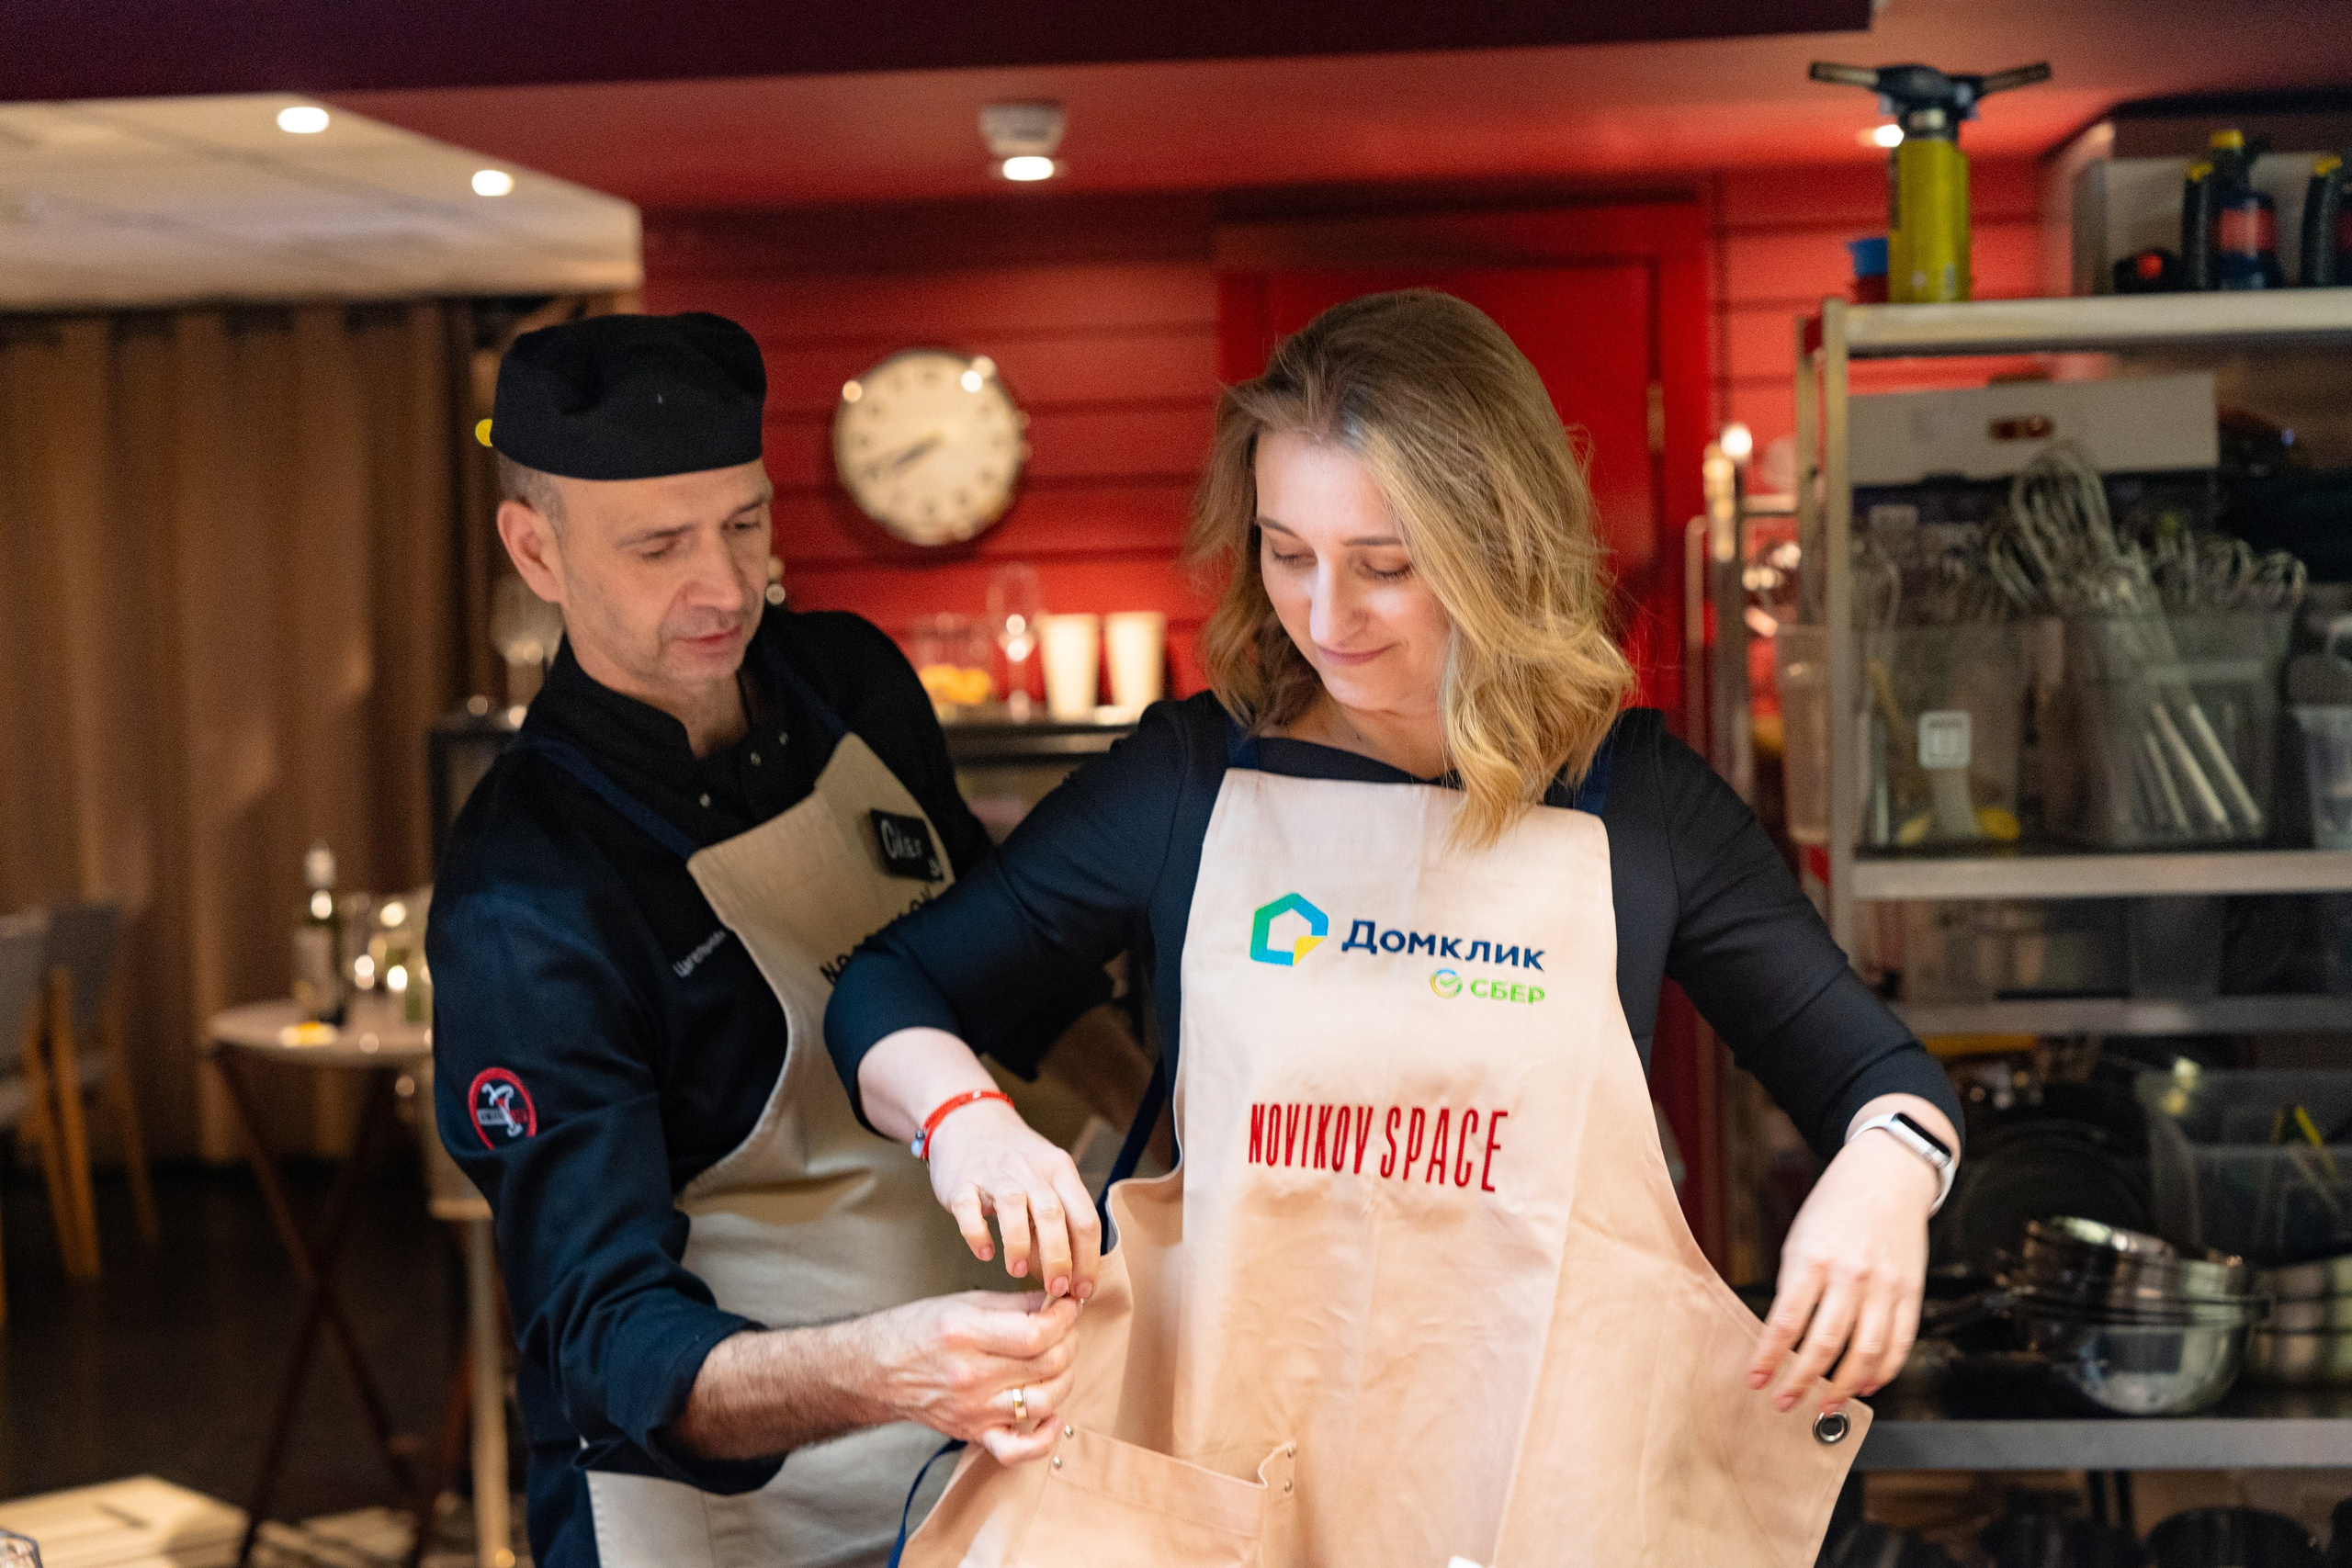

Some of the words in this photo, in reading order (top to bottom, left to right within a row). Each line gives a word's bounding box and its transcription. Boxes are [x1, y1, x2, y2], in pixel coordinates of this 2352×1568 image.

[1341, 919, 1545, 972] Домклик
[1470, 977, 1545, 1004] СБЕР
[1249, 1103, 1374, 1175] NOVIKOV
[1380, 1106, 1509, 1192] SPACE
